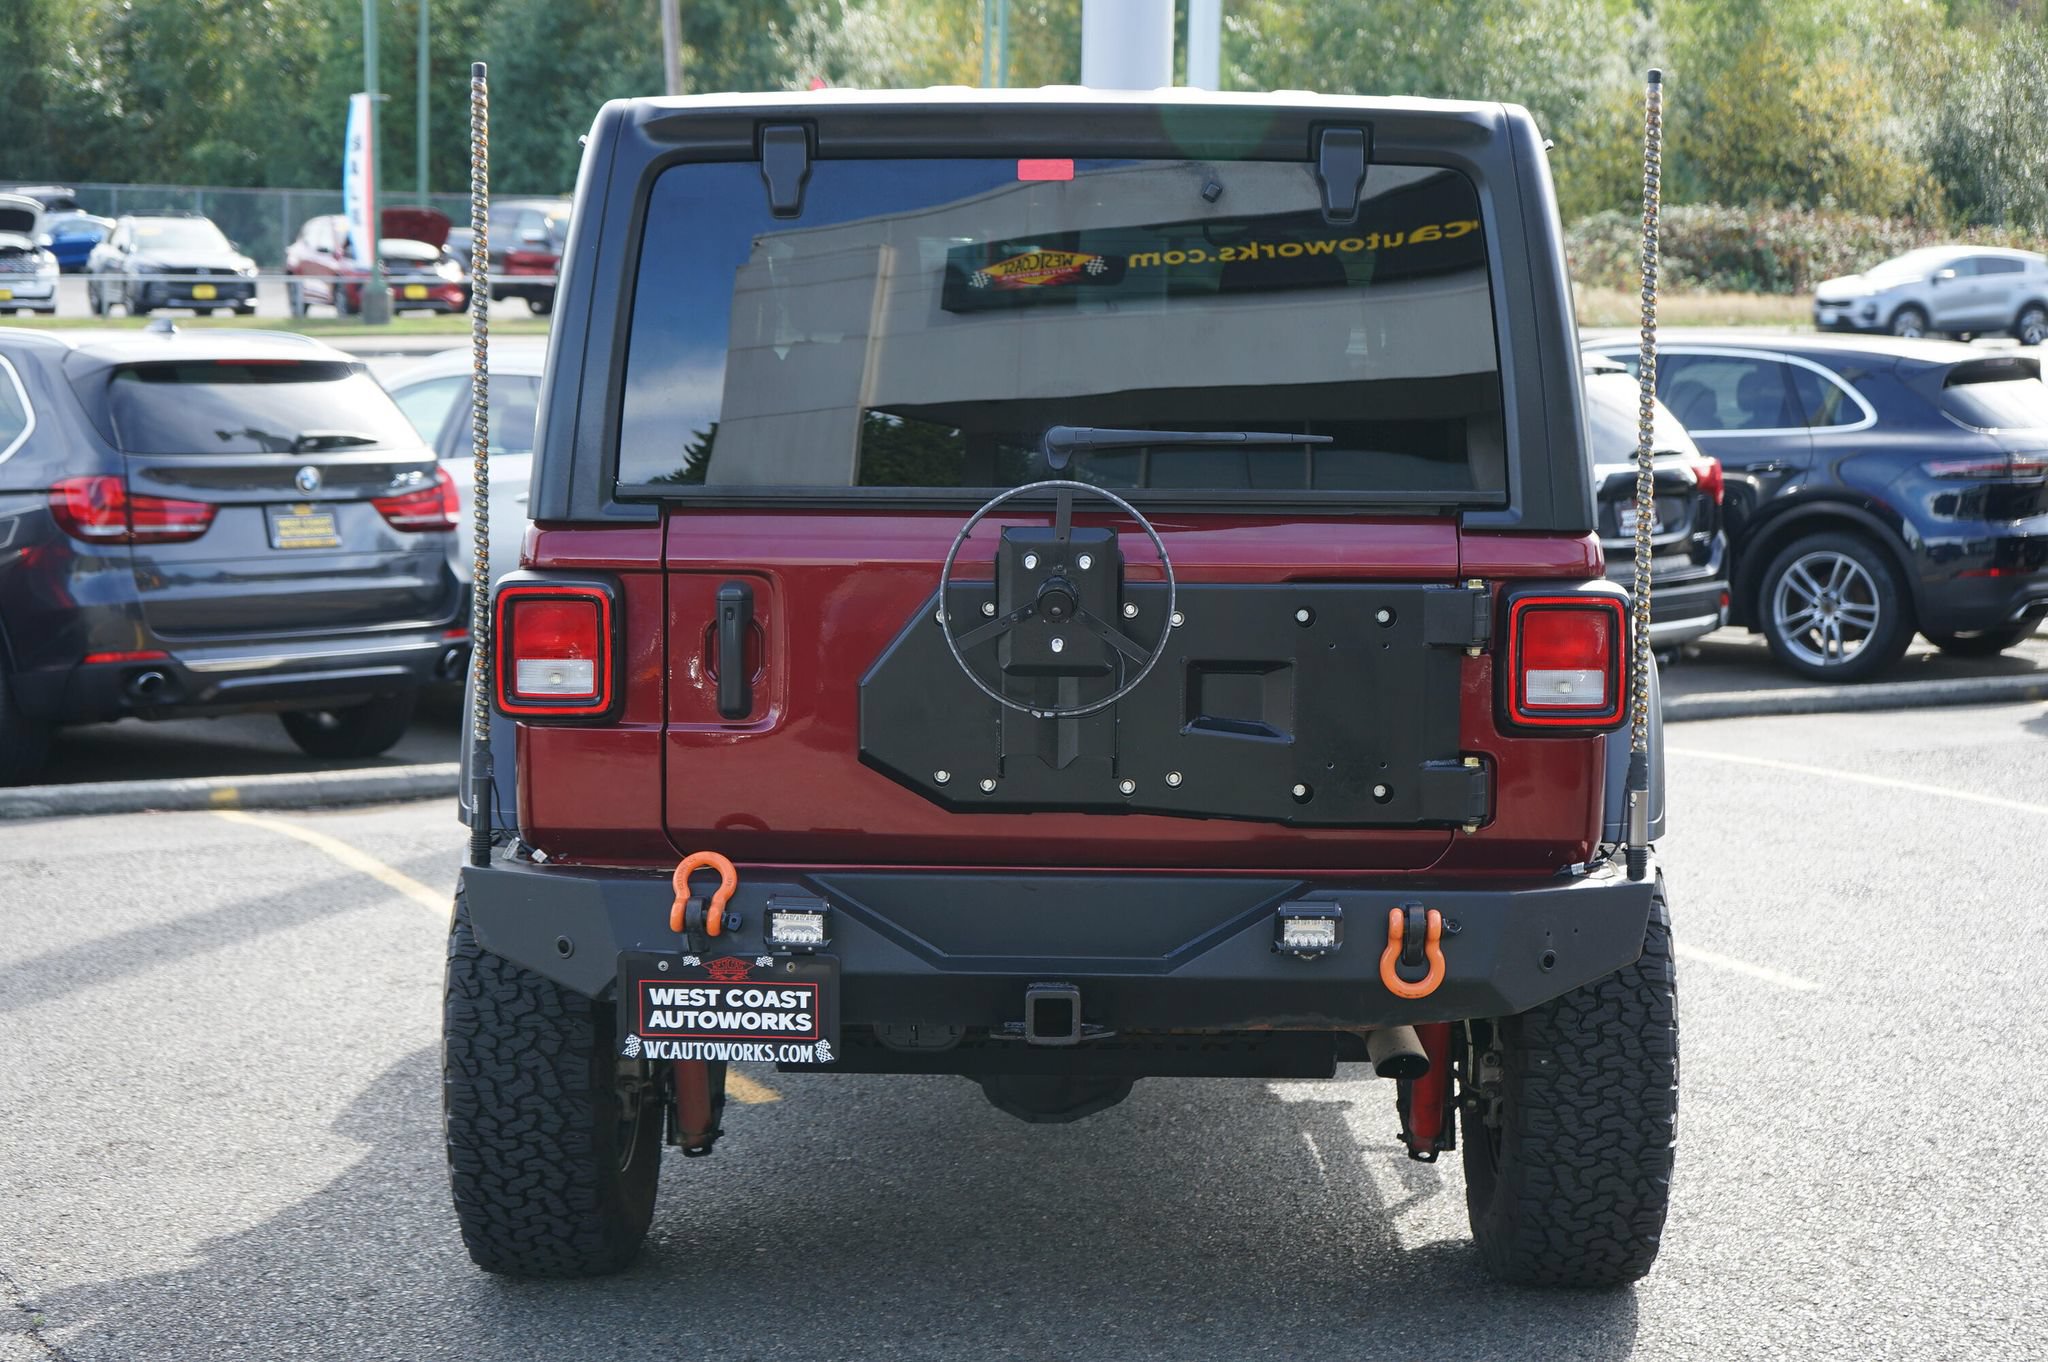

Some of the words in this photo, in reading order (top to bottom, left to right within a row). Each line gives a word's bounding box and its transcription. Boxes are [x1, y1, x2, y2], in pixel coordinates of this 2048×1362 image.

[649, 988, 720, 1006] WEST
[726, 990, 812, 1009] COAST
[649, 1010, 812, 1031] AUTOWORKS
[643, 1041, 813, 1063] WCAUTOWORKS.COM
